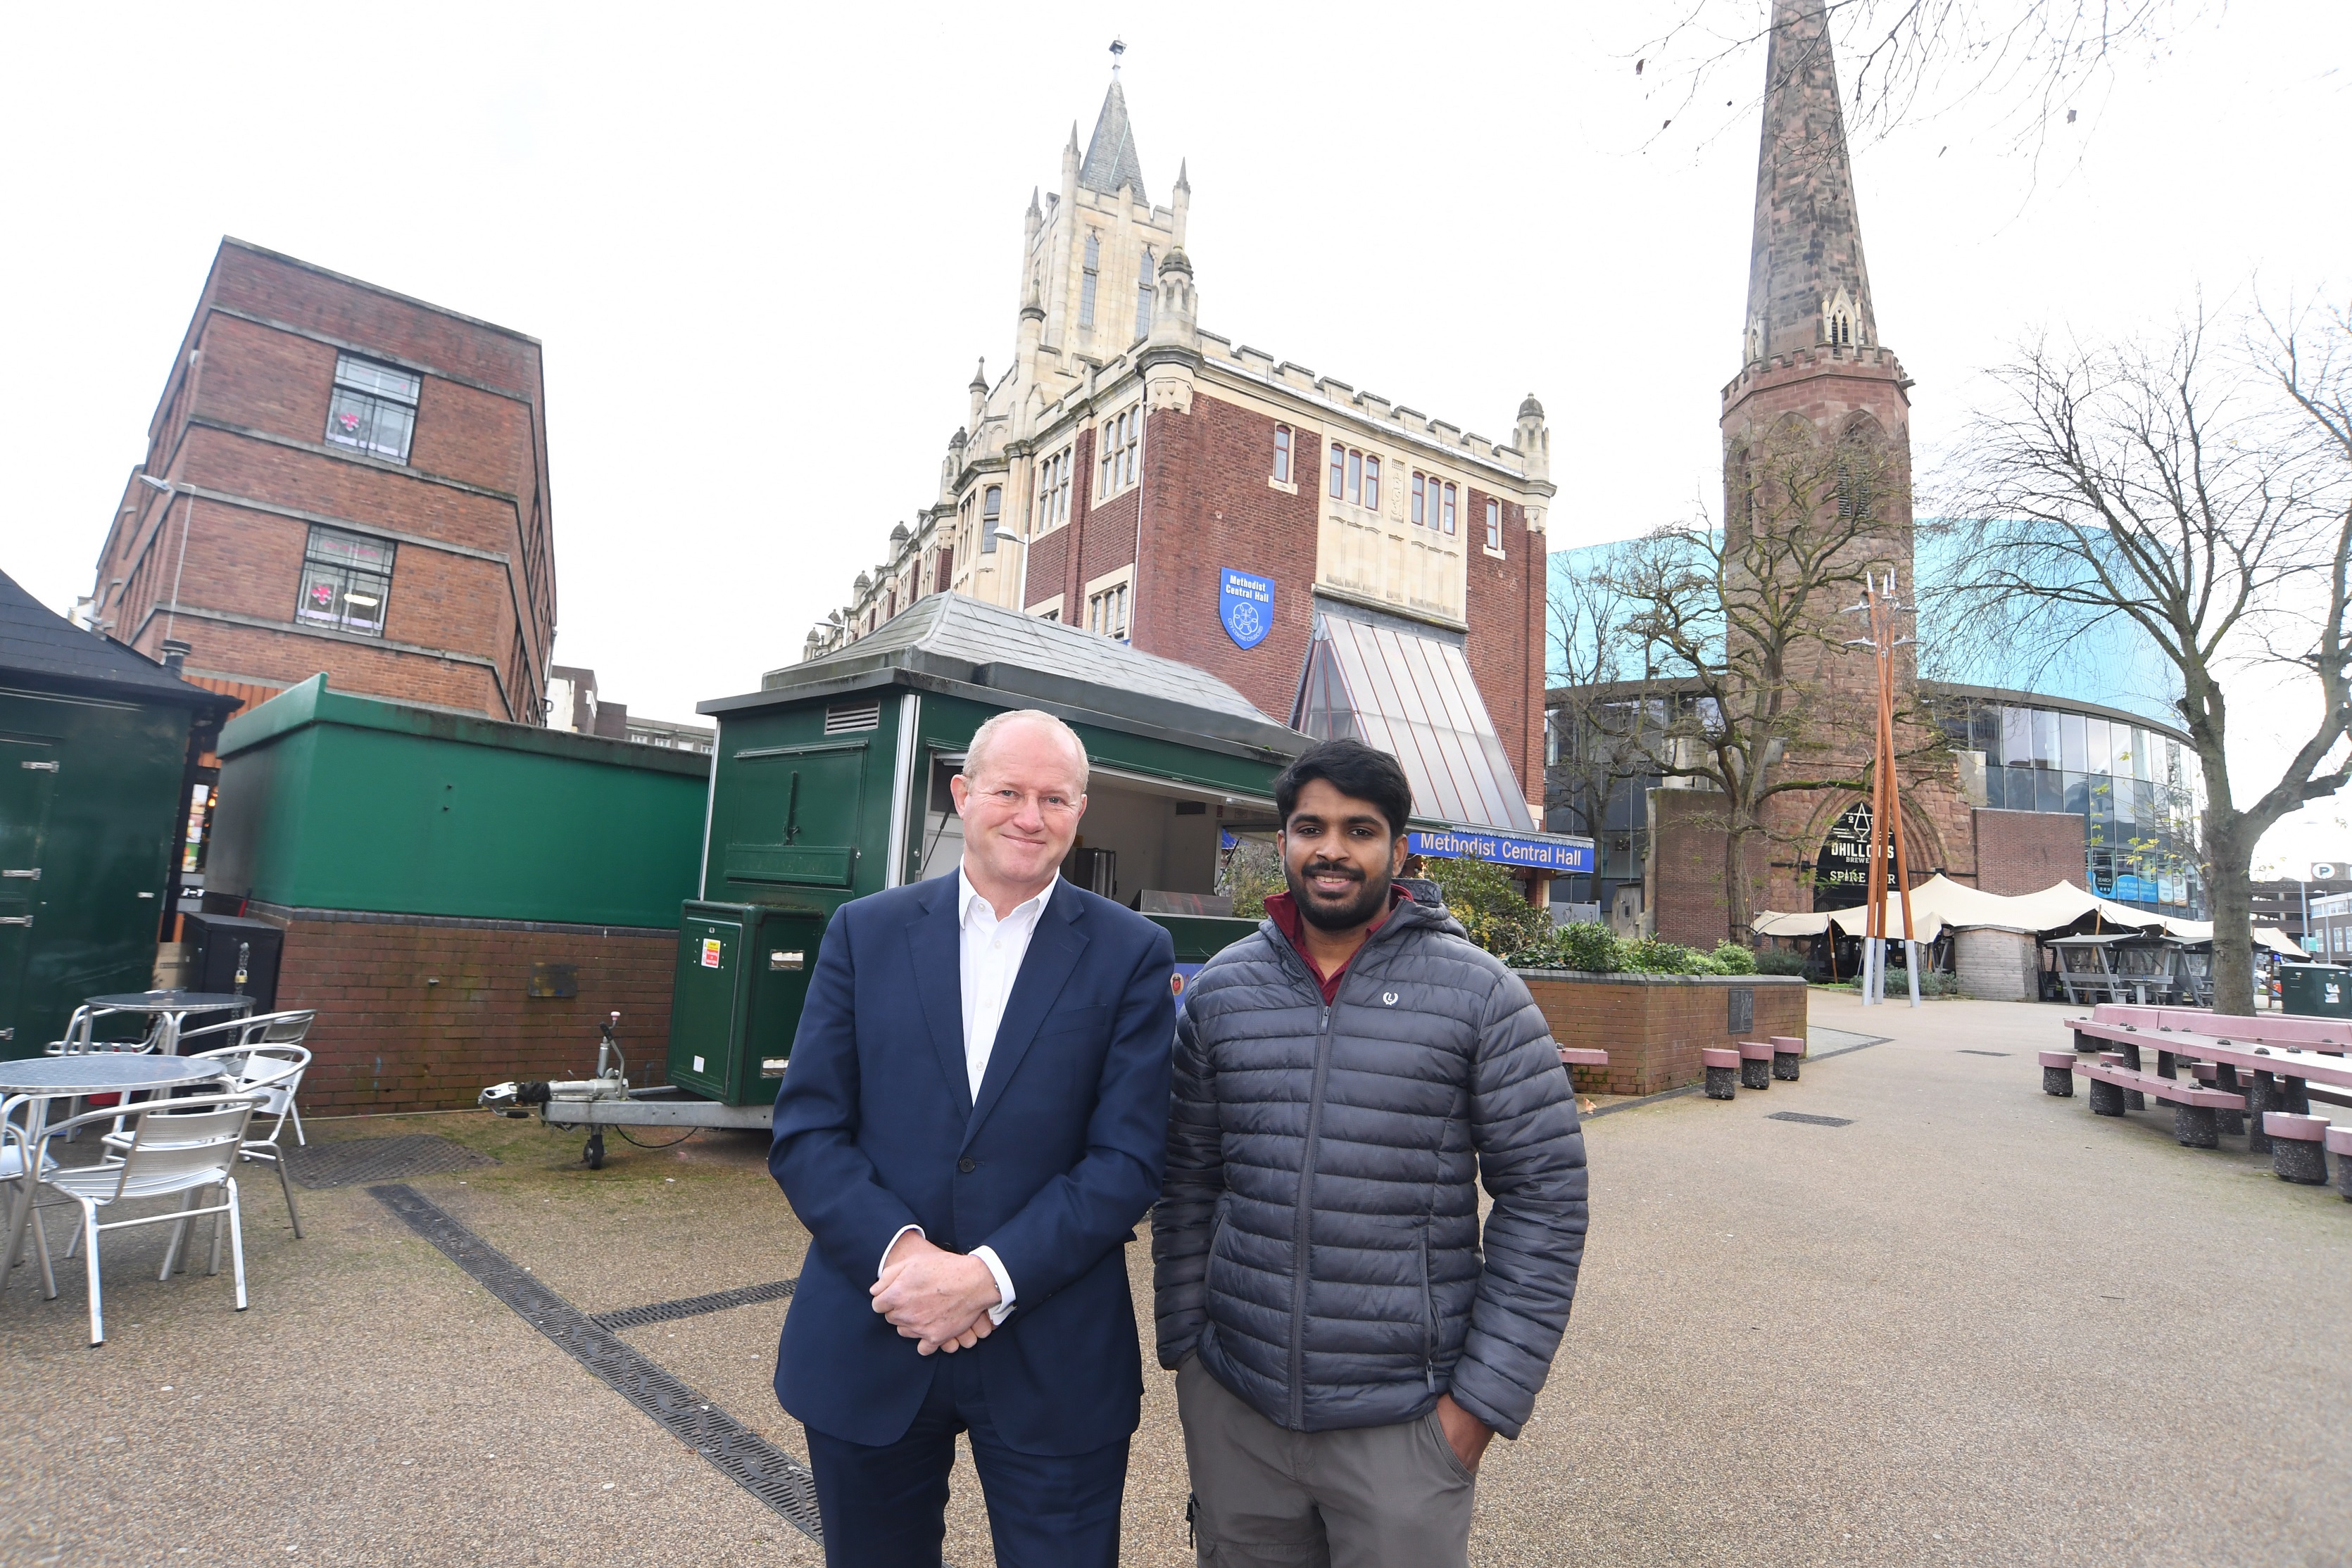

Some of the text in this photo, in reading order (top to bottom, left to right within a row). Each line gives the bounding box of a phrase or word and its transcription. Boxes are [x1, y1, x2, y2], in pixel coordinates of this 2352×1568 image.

[1229, 574, 1266, 592] Methodist
[1226, 584, 1269, 603] Central Hall
[1232, 628, 1247, 641] CENTRE
[1246, 625, 1264, 642] CHURCHES
[1421, 833, 1581, 866] Methodist Central Hall
